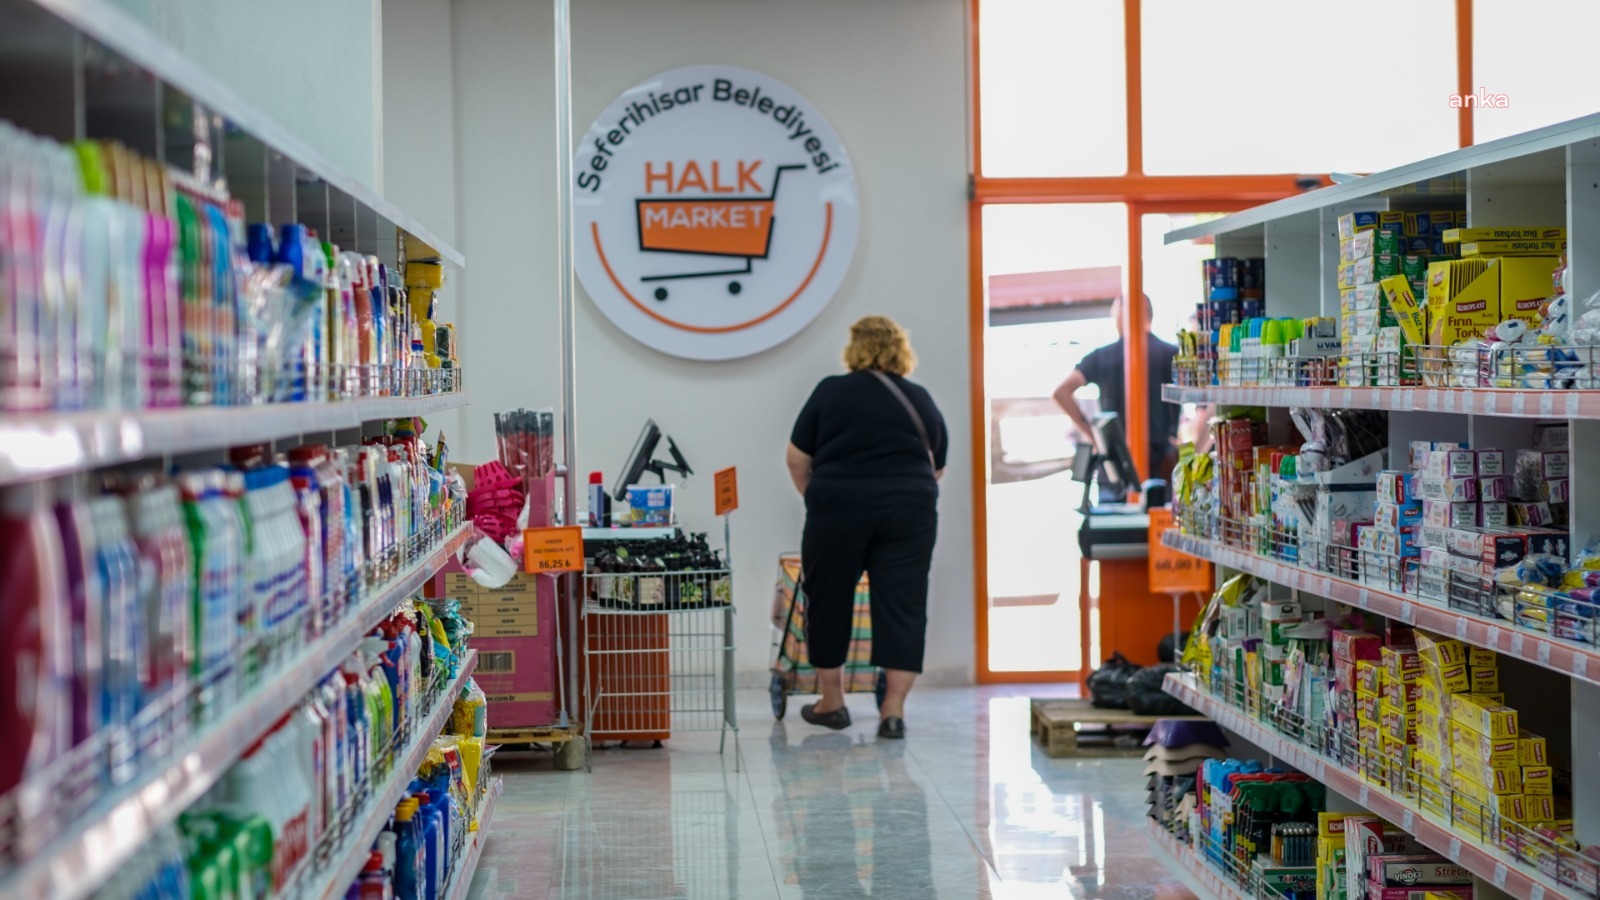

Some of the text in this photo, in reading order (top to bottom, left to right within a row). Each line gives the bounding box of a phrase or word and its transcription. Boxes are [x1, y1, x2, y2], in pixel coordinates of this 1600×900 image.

[577, 78, 840, 193] Seferihisar Belediyesi
[644, 160, 765, 194] HALK
[644, 205, 766, 229] MARKET
[1457, 301, 1486, 312] KOROPLAST
[539, 559, 563, 569] 86,25
